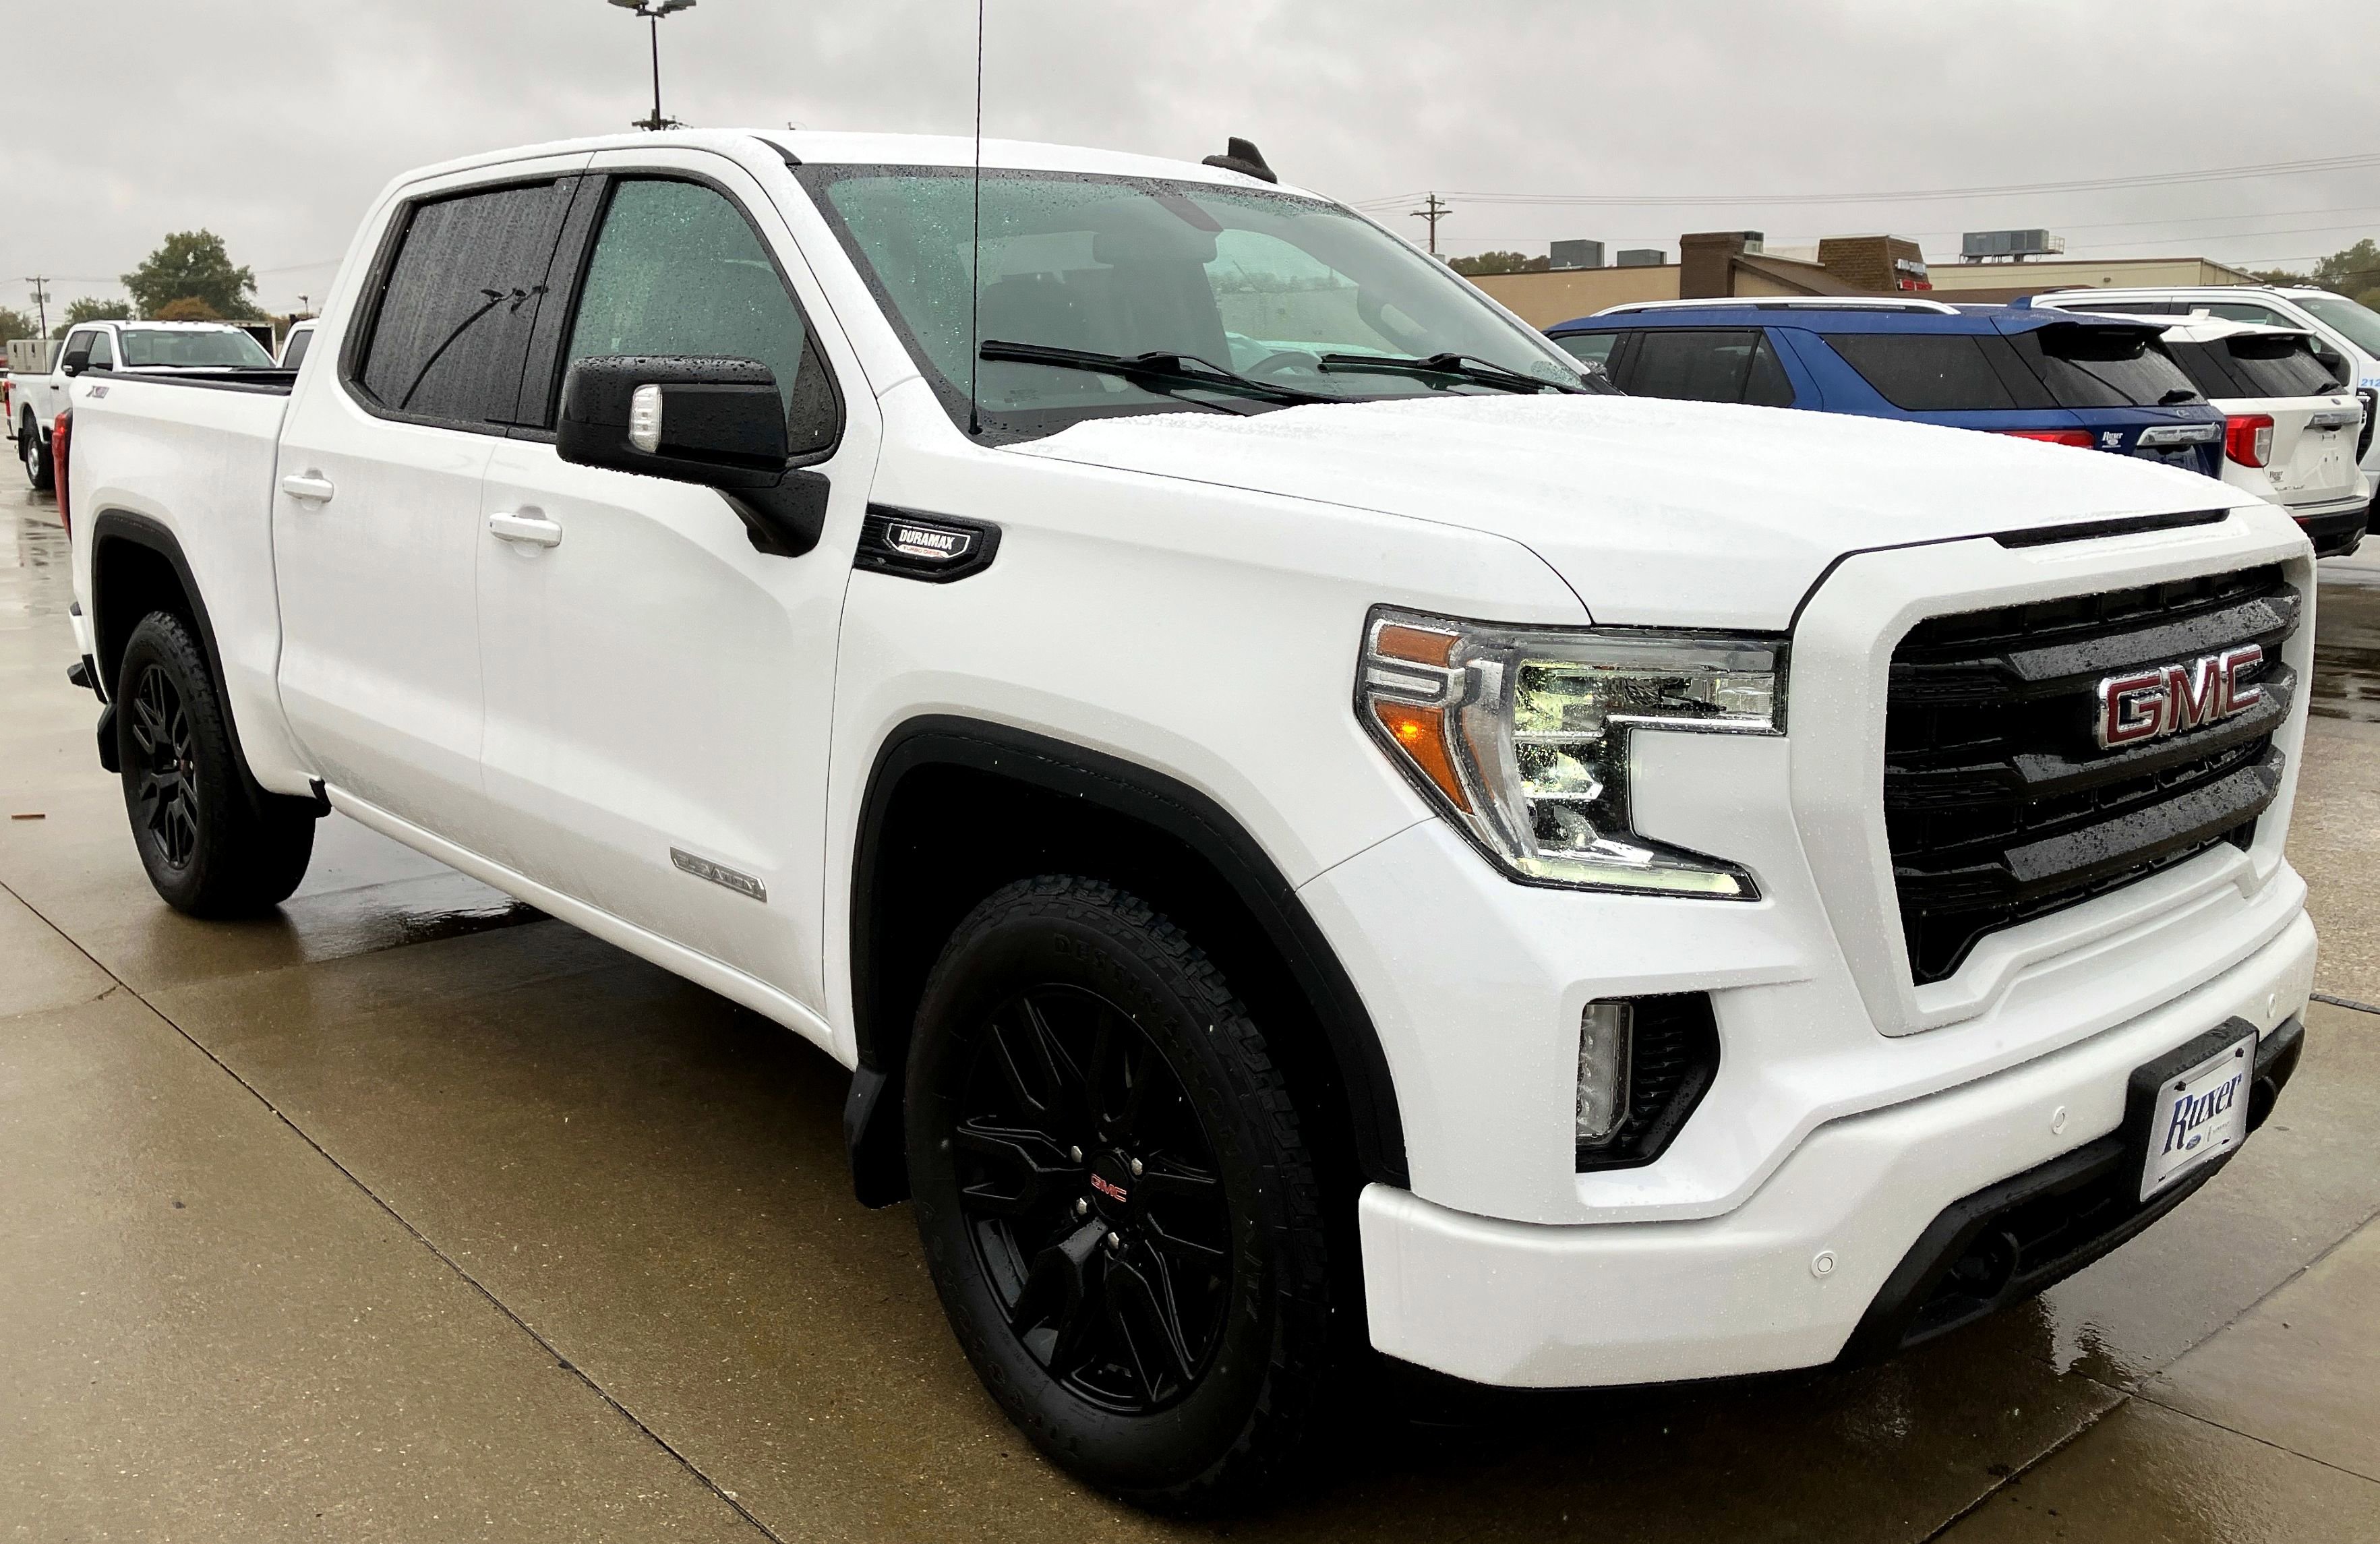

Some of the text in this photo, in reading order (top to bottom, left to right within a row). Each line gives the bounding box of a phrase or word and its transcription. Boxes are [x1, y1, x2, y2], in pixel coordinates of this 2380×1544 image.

[899, 529, 955, 550] DURAMAX
[903, 545, 923, 554] TURBO
[2099, 644, 2263, 750] GMC
[2162, 1073, 2242, 1155] Ruxer
[1091, 1173, 1127, 1203] GMC
